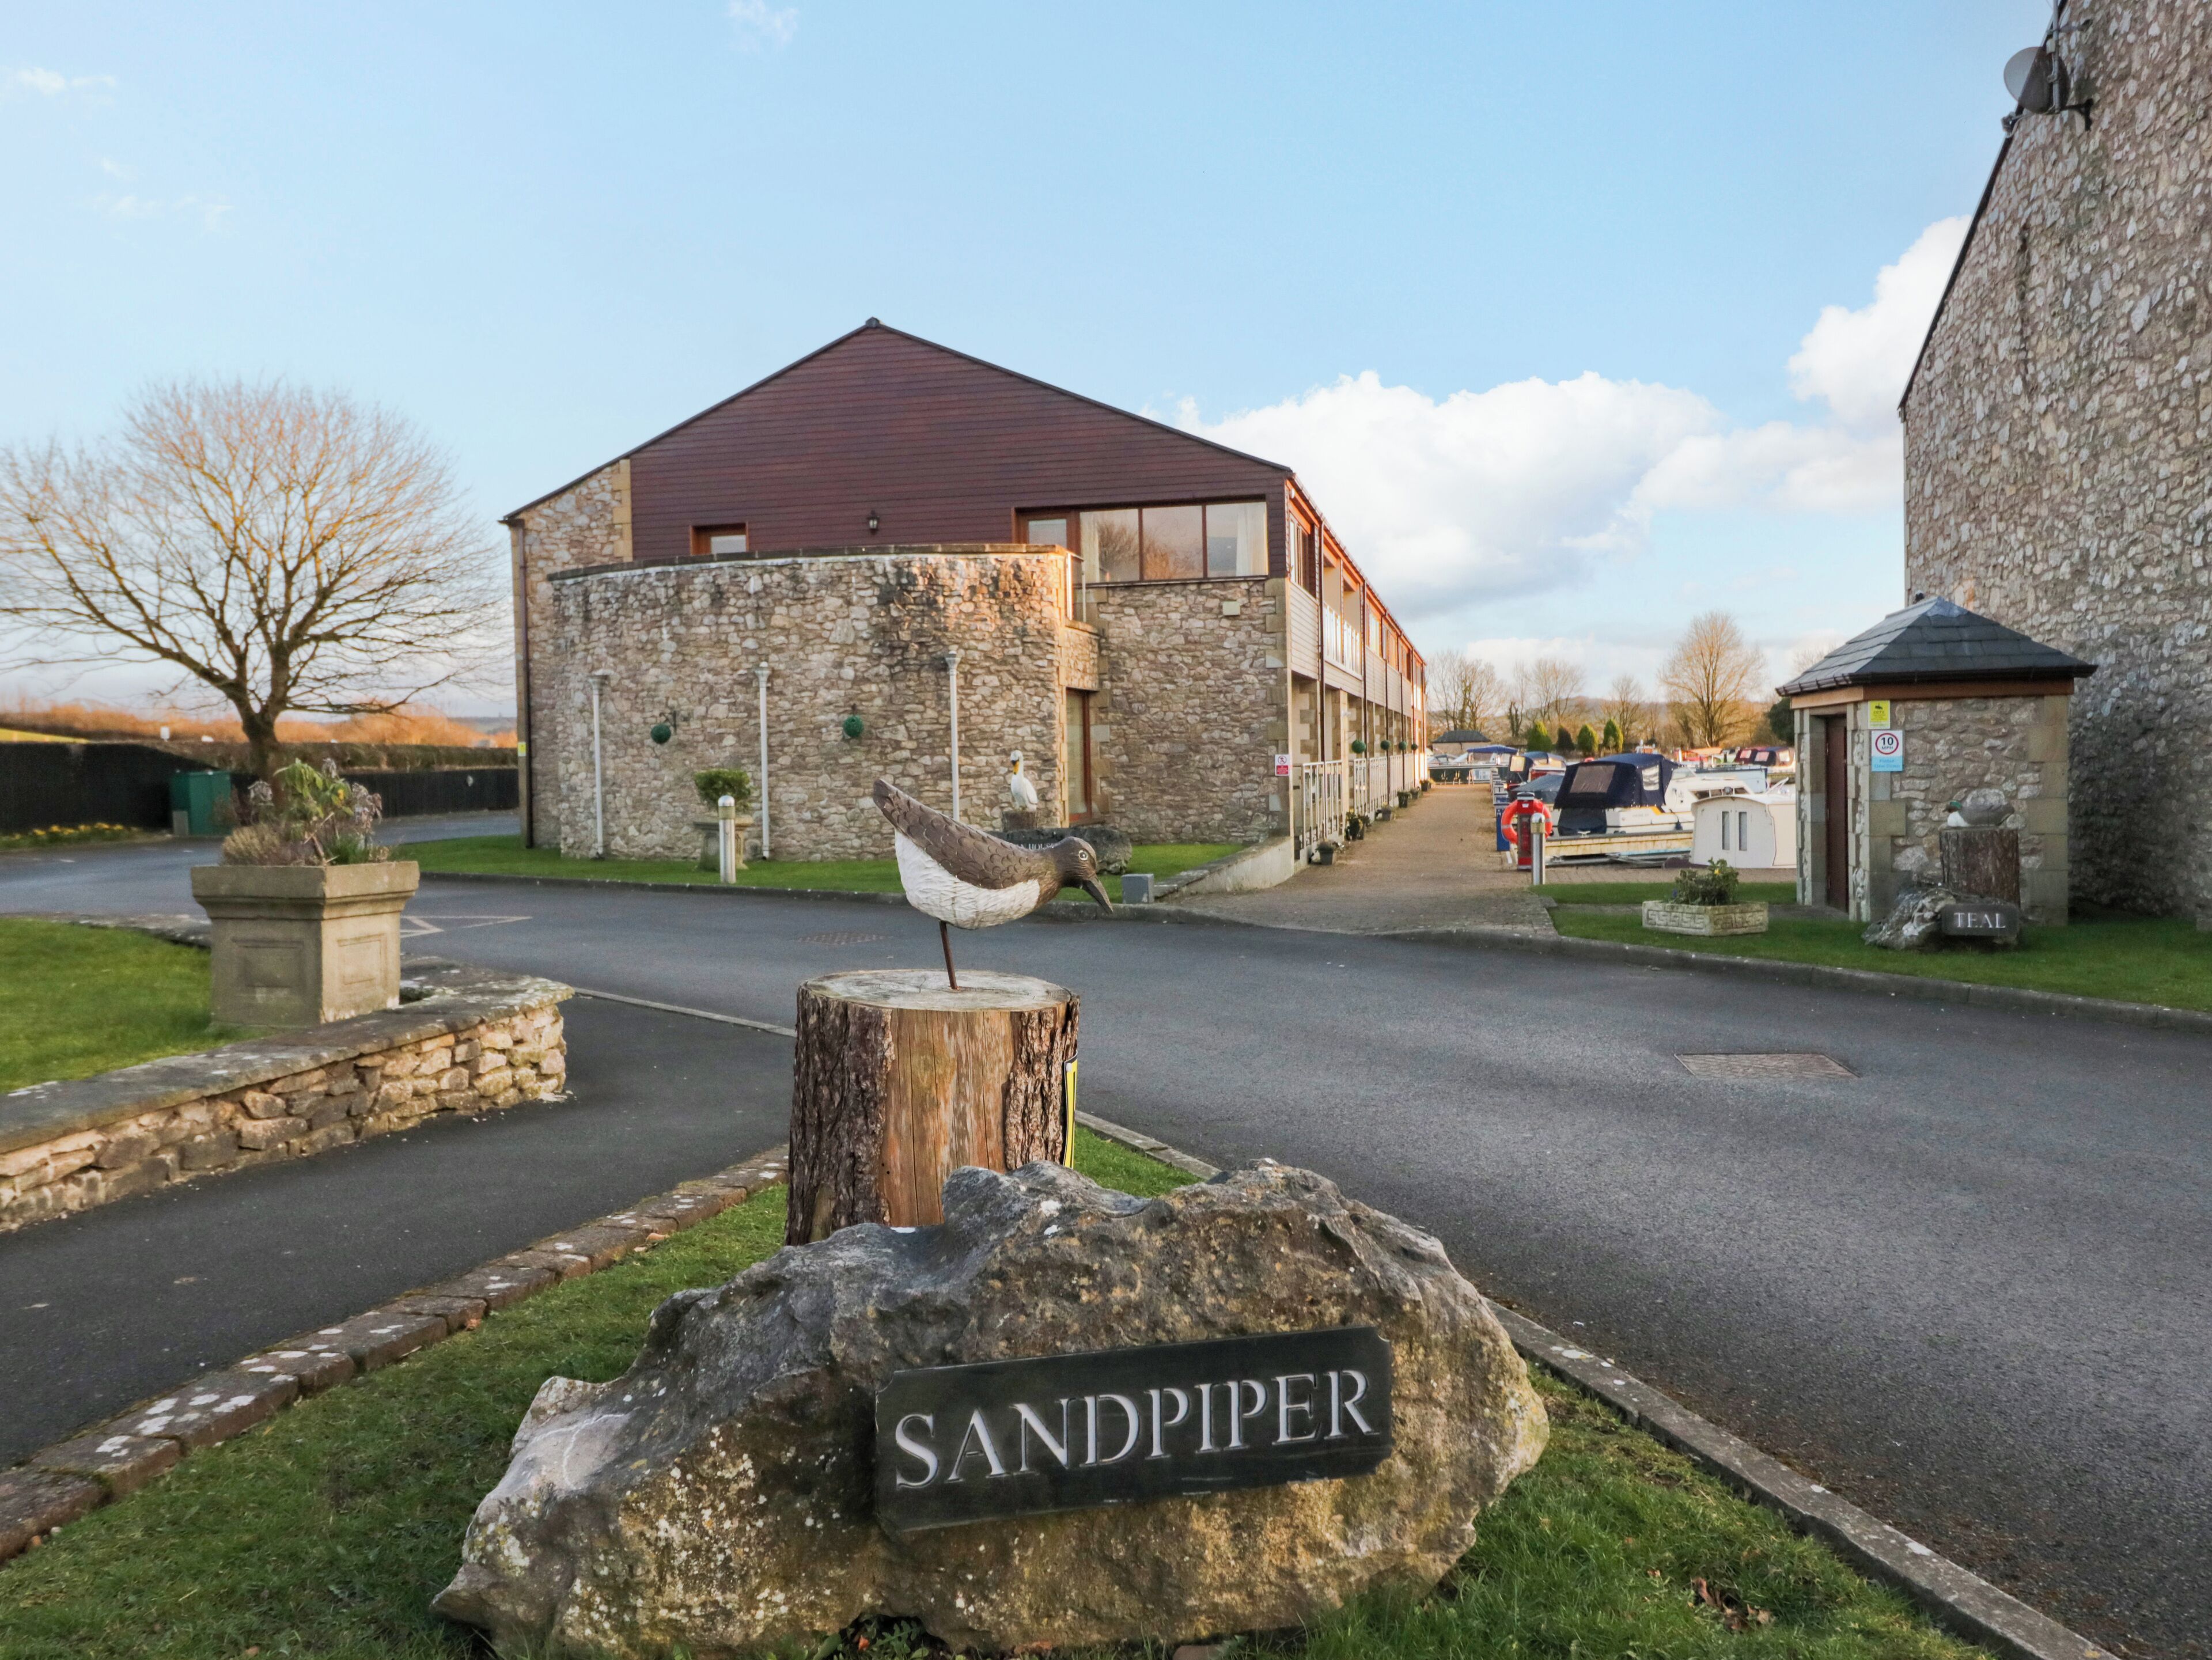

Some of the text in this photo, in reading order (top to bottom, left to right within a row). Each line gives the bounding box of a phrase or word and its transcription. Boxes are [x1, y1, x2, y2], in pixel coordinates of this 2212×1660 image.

[1881, 737, 1894, 746] 10
[1953, 912, 2006, 928] TEAL
[895, 1369, 1380, 1491] SANDPIPER
